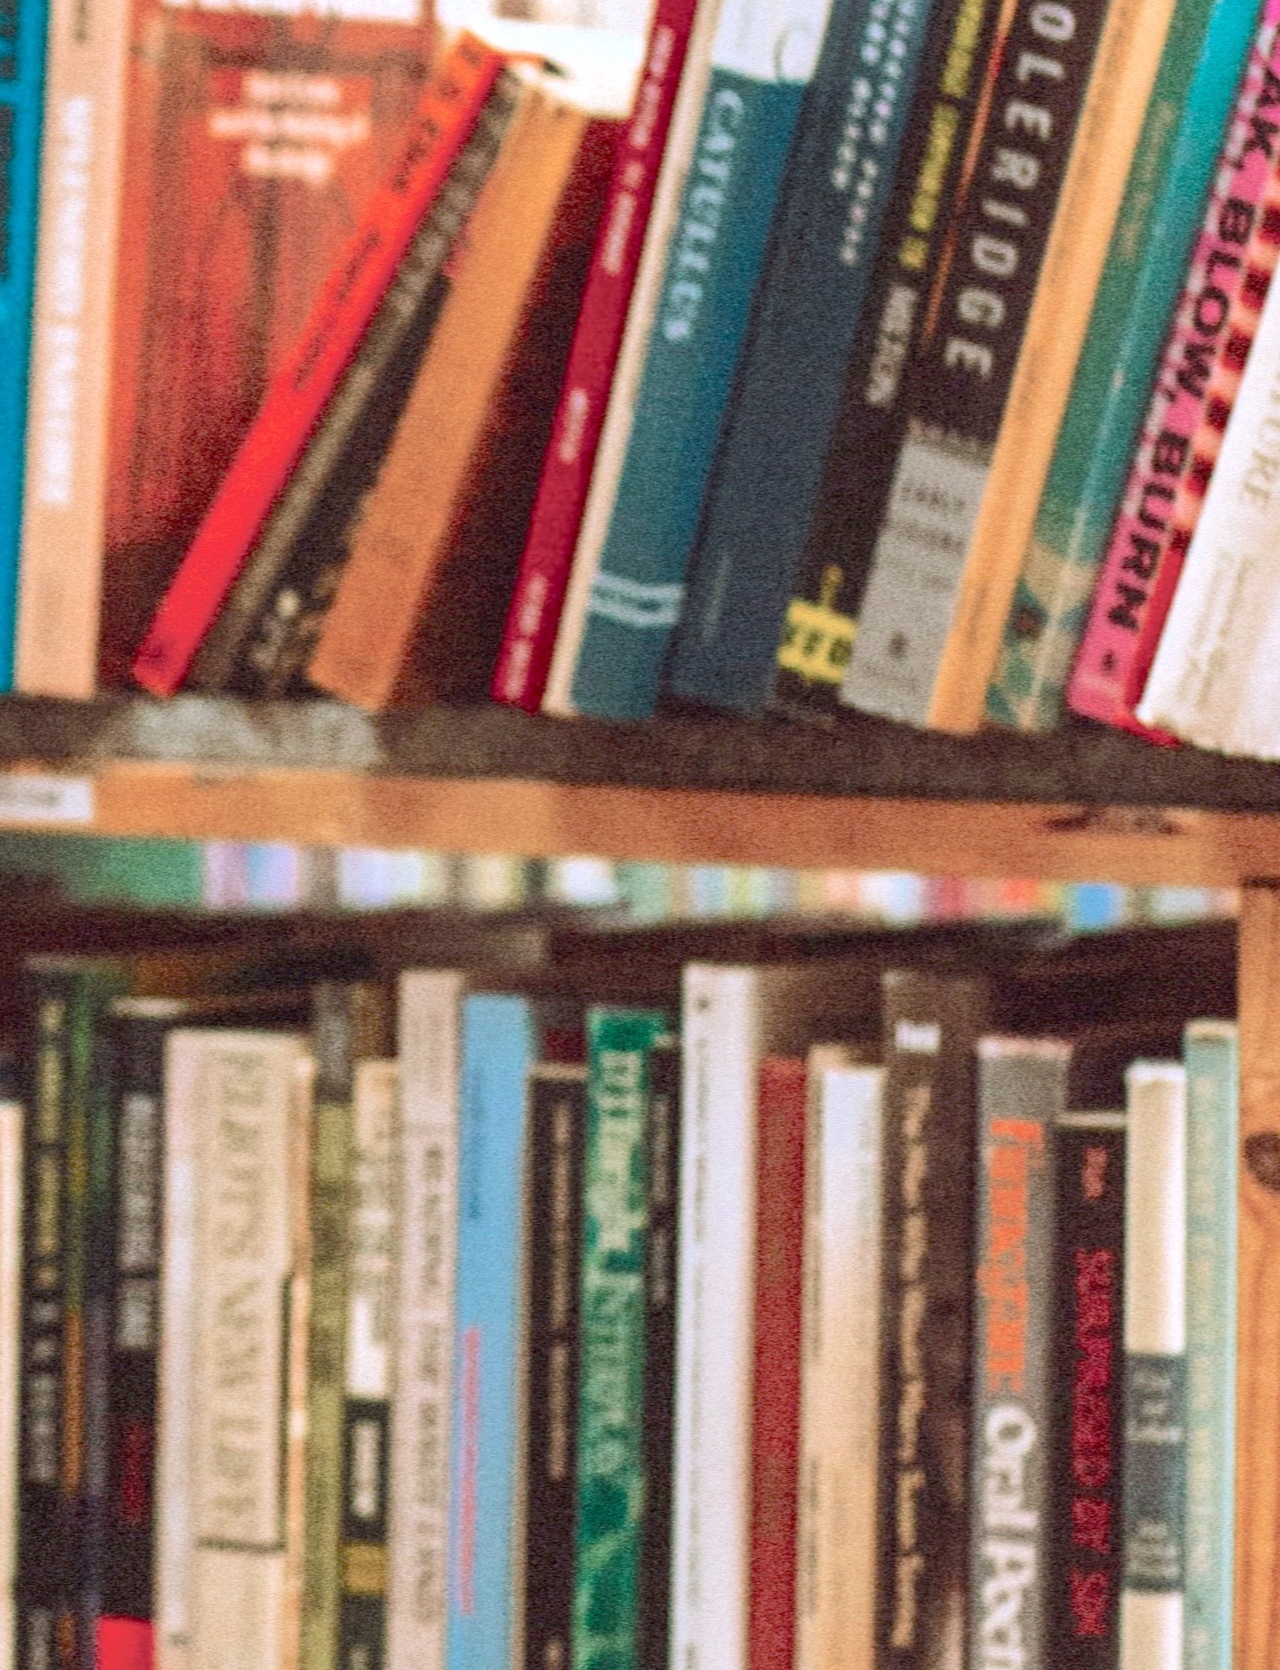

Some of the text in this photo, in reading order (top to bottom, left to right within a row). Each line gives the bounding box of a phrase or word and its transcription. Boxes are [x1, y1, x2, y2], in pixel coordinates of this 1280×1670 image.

[662, 88, 744, 343] CATULLUS
[1105, 65, 1280, 632] AK, BLOW, BURN
[985, 1403, 1038, 1529] Oral
[1071, 1247, 1115, 1487] SURPRISED
